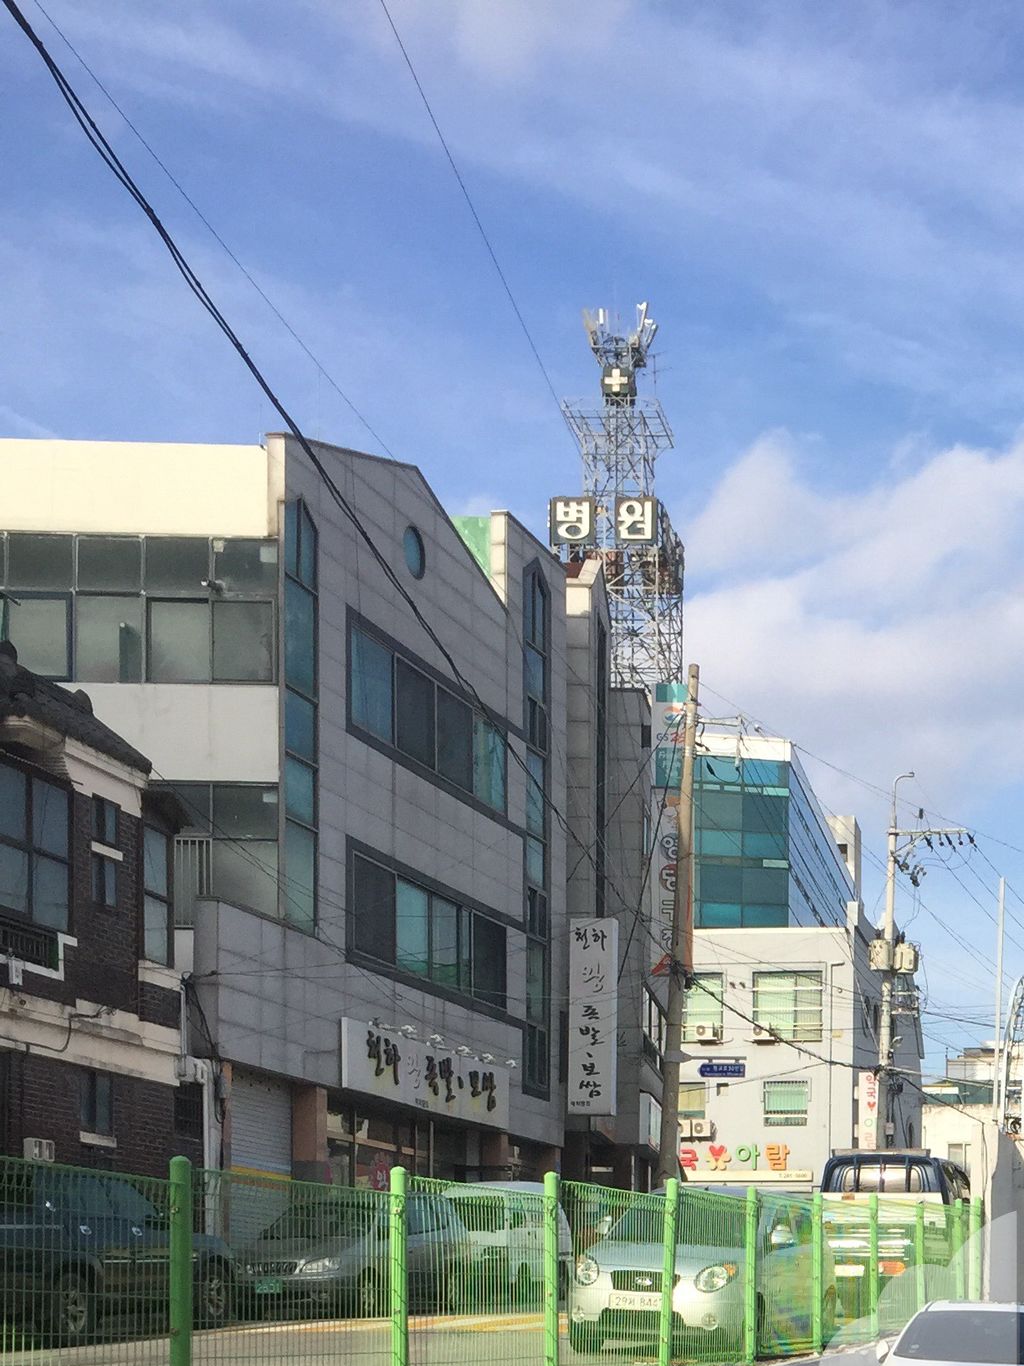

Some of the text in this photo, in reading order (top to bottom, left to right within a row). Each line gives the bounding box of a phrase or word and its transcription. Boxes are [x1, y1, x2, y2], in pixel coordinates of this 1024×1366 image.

[555, 500, 653, 540] 병원
[575, 927, 607, 951] 천하
[736, 1143, 790, 1171] 아람
